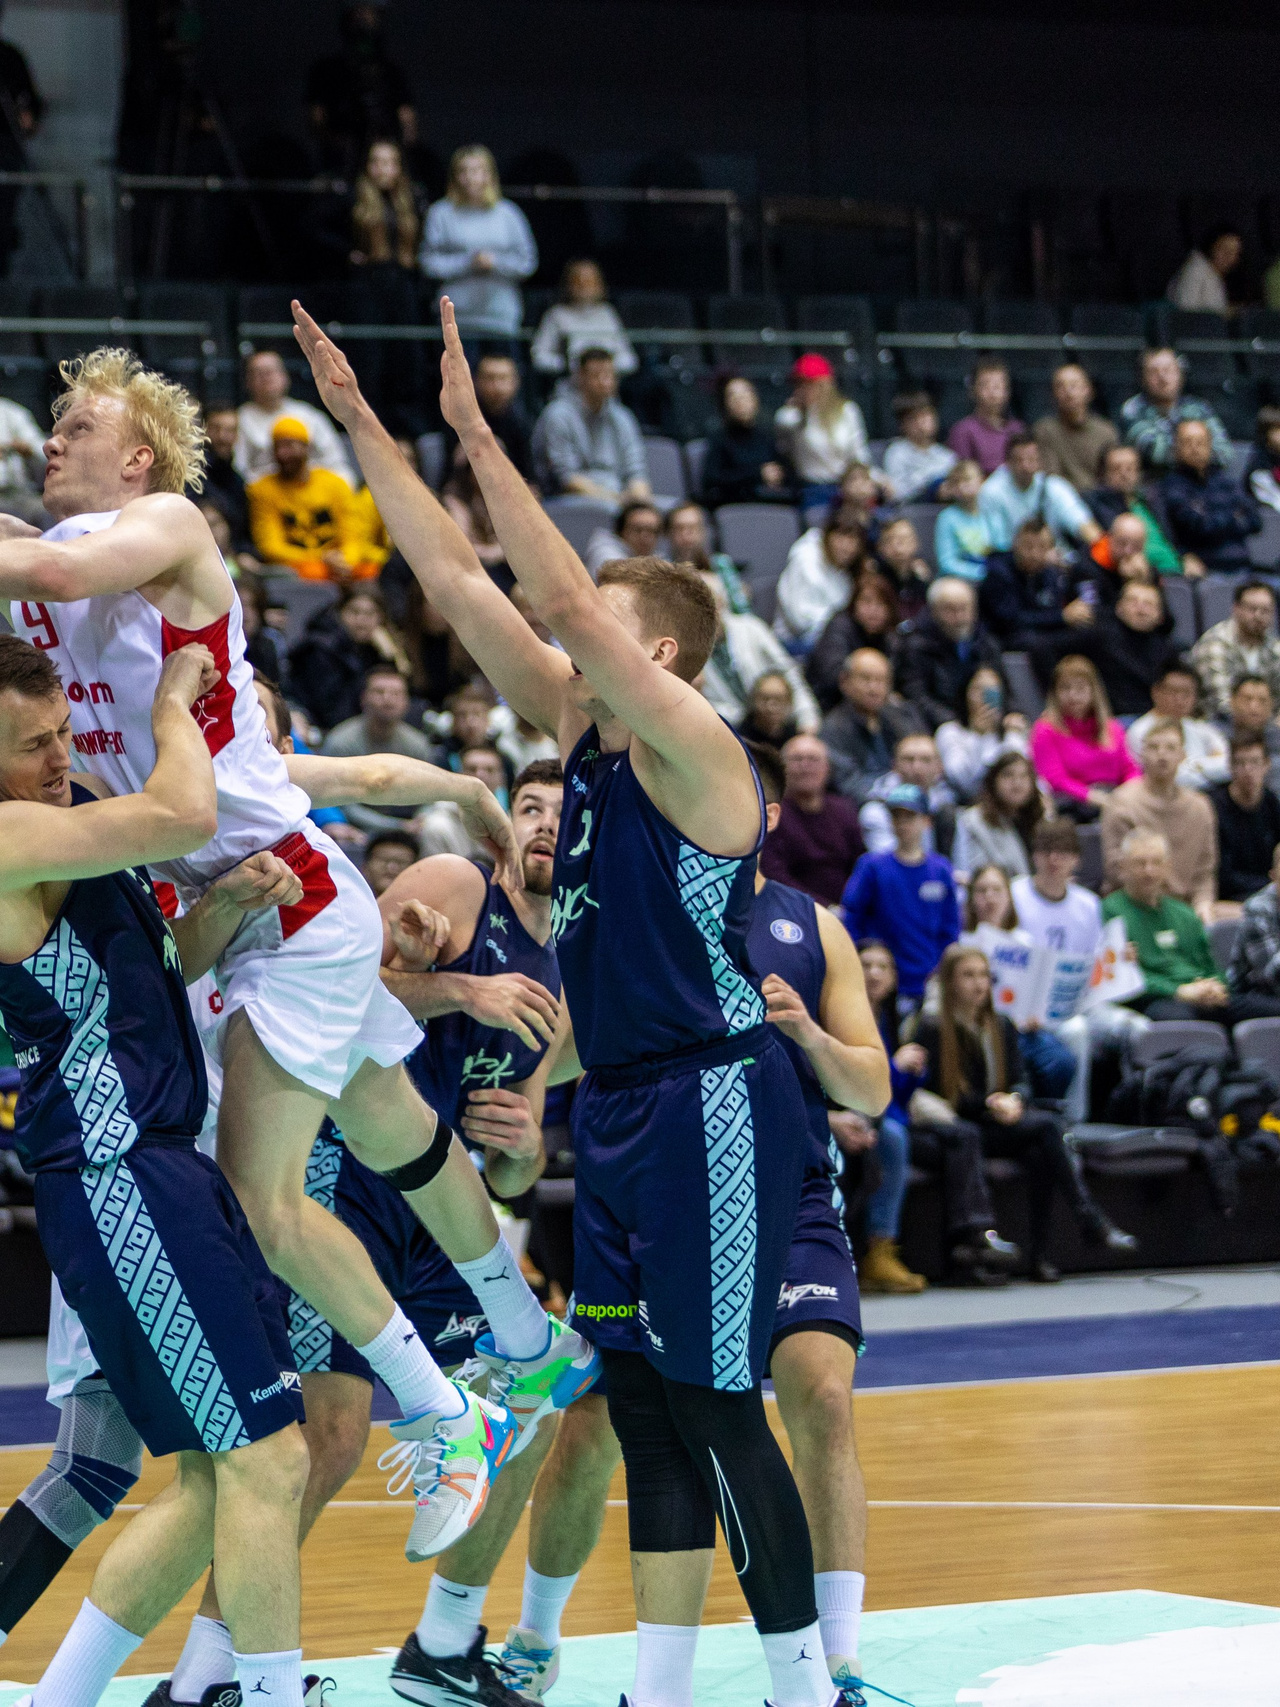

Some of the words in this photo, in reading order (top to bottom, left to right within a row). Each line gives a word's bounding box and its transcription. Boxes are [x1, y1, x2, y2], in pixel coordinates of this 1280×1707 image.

[21, 601, 59, 650] 9
[575, 1303, 638, 1322] еврооп
[249, 1379, 284, 1404] Kemp
